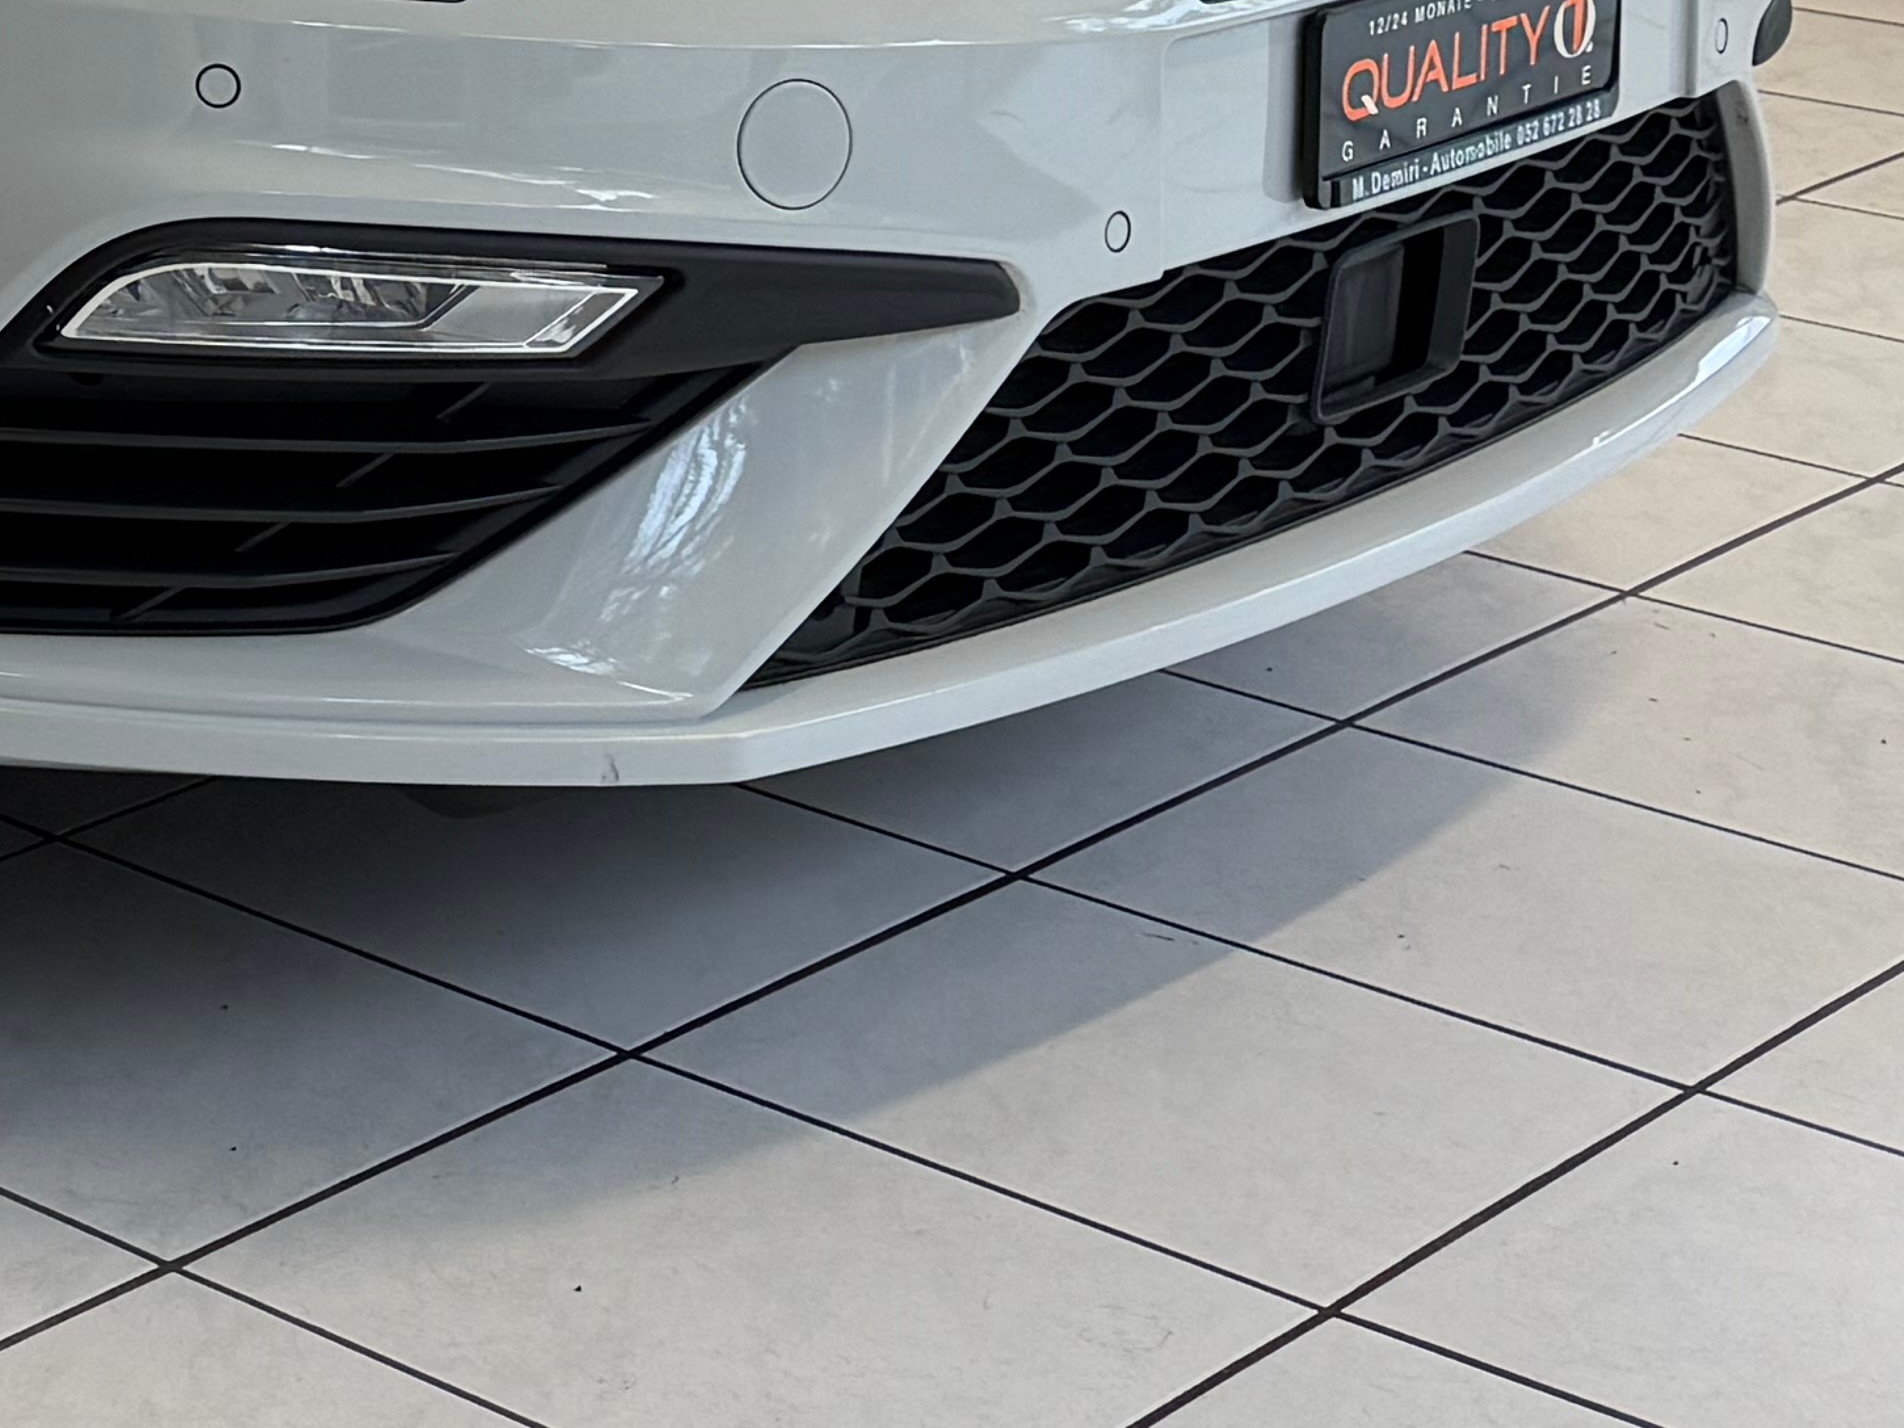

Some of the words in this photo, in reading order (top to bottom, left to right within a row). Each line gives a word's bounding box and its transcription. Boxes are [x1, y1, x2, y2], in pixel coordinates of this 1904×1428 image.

[1341, 64, 1593, 163] GARANTIE
[1515, 120, 1540, 146] 052
[1542, 113, 1566, 138] 672
[1567, 105, 1584, 129] 28
[1585, 99, 1602, 122] 28
